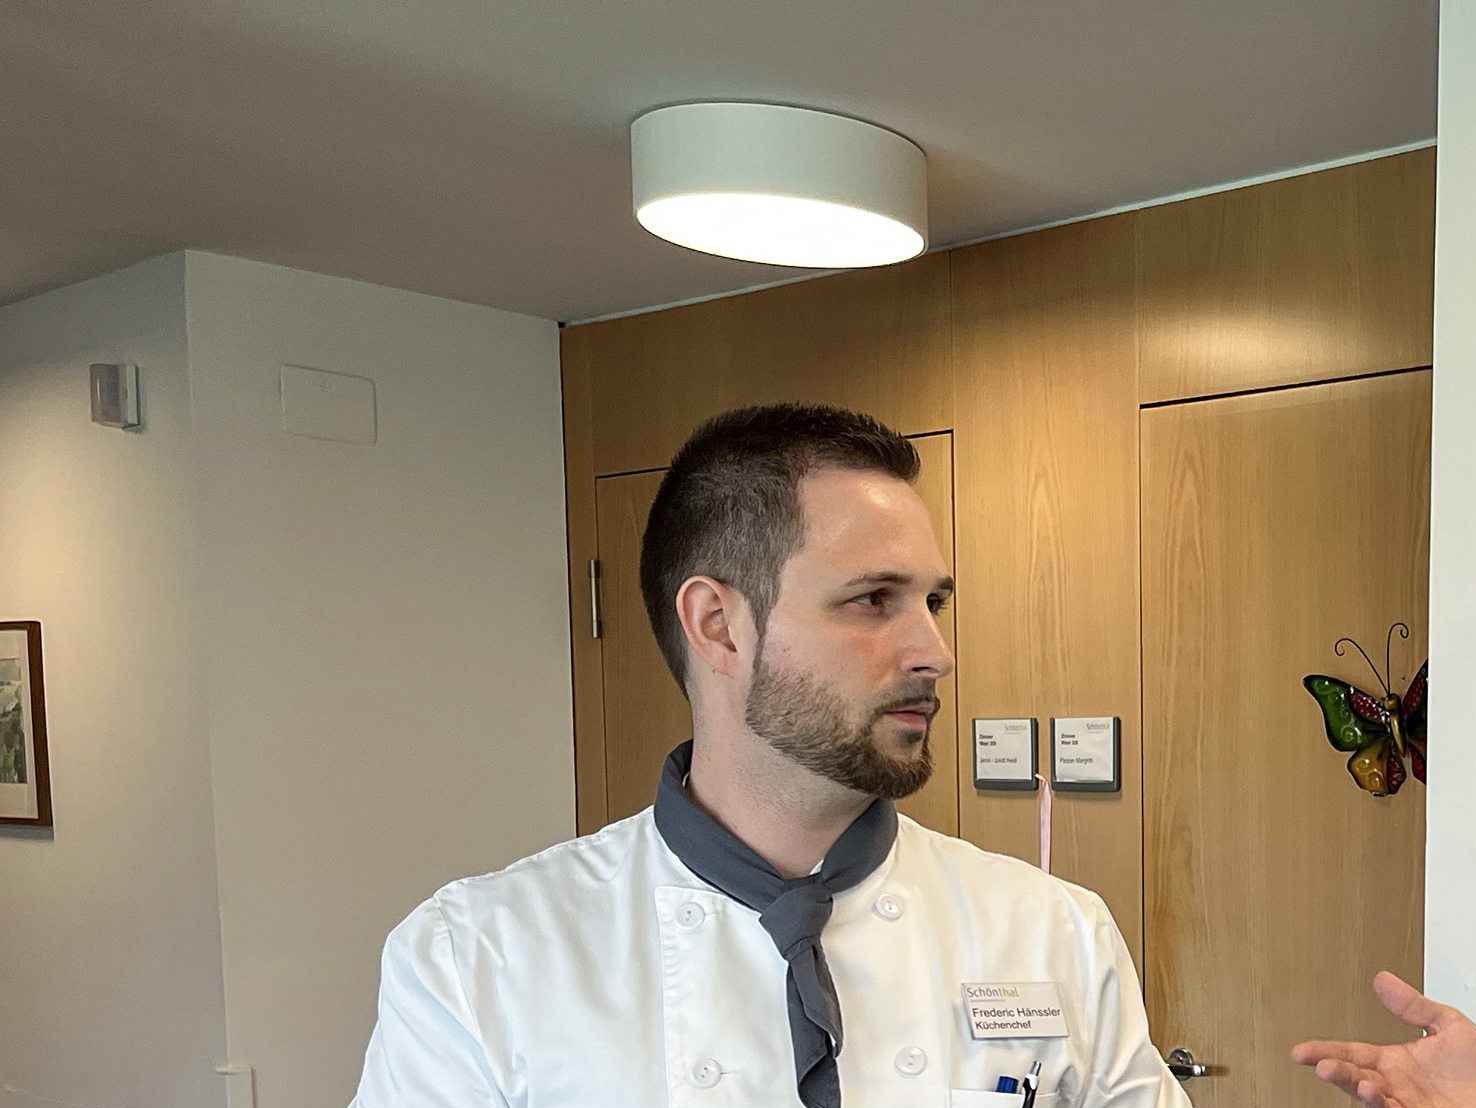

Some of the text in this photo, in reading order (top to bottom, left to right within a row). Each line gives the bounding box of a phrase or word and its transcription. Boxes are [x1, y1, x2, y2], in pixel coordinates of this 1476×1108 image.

[966, 987, 1020, 998] Schönthal
[972, 1007, 1061, 1018] Frederic Hänssler
[975, 1020, 1032, 1030] Küchenchef
